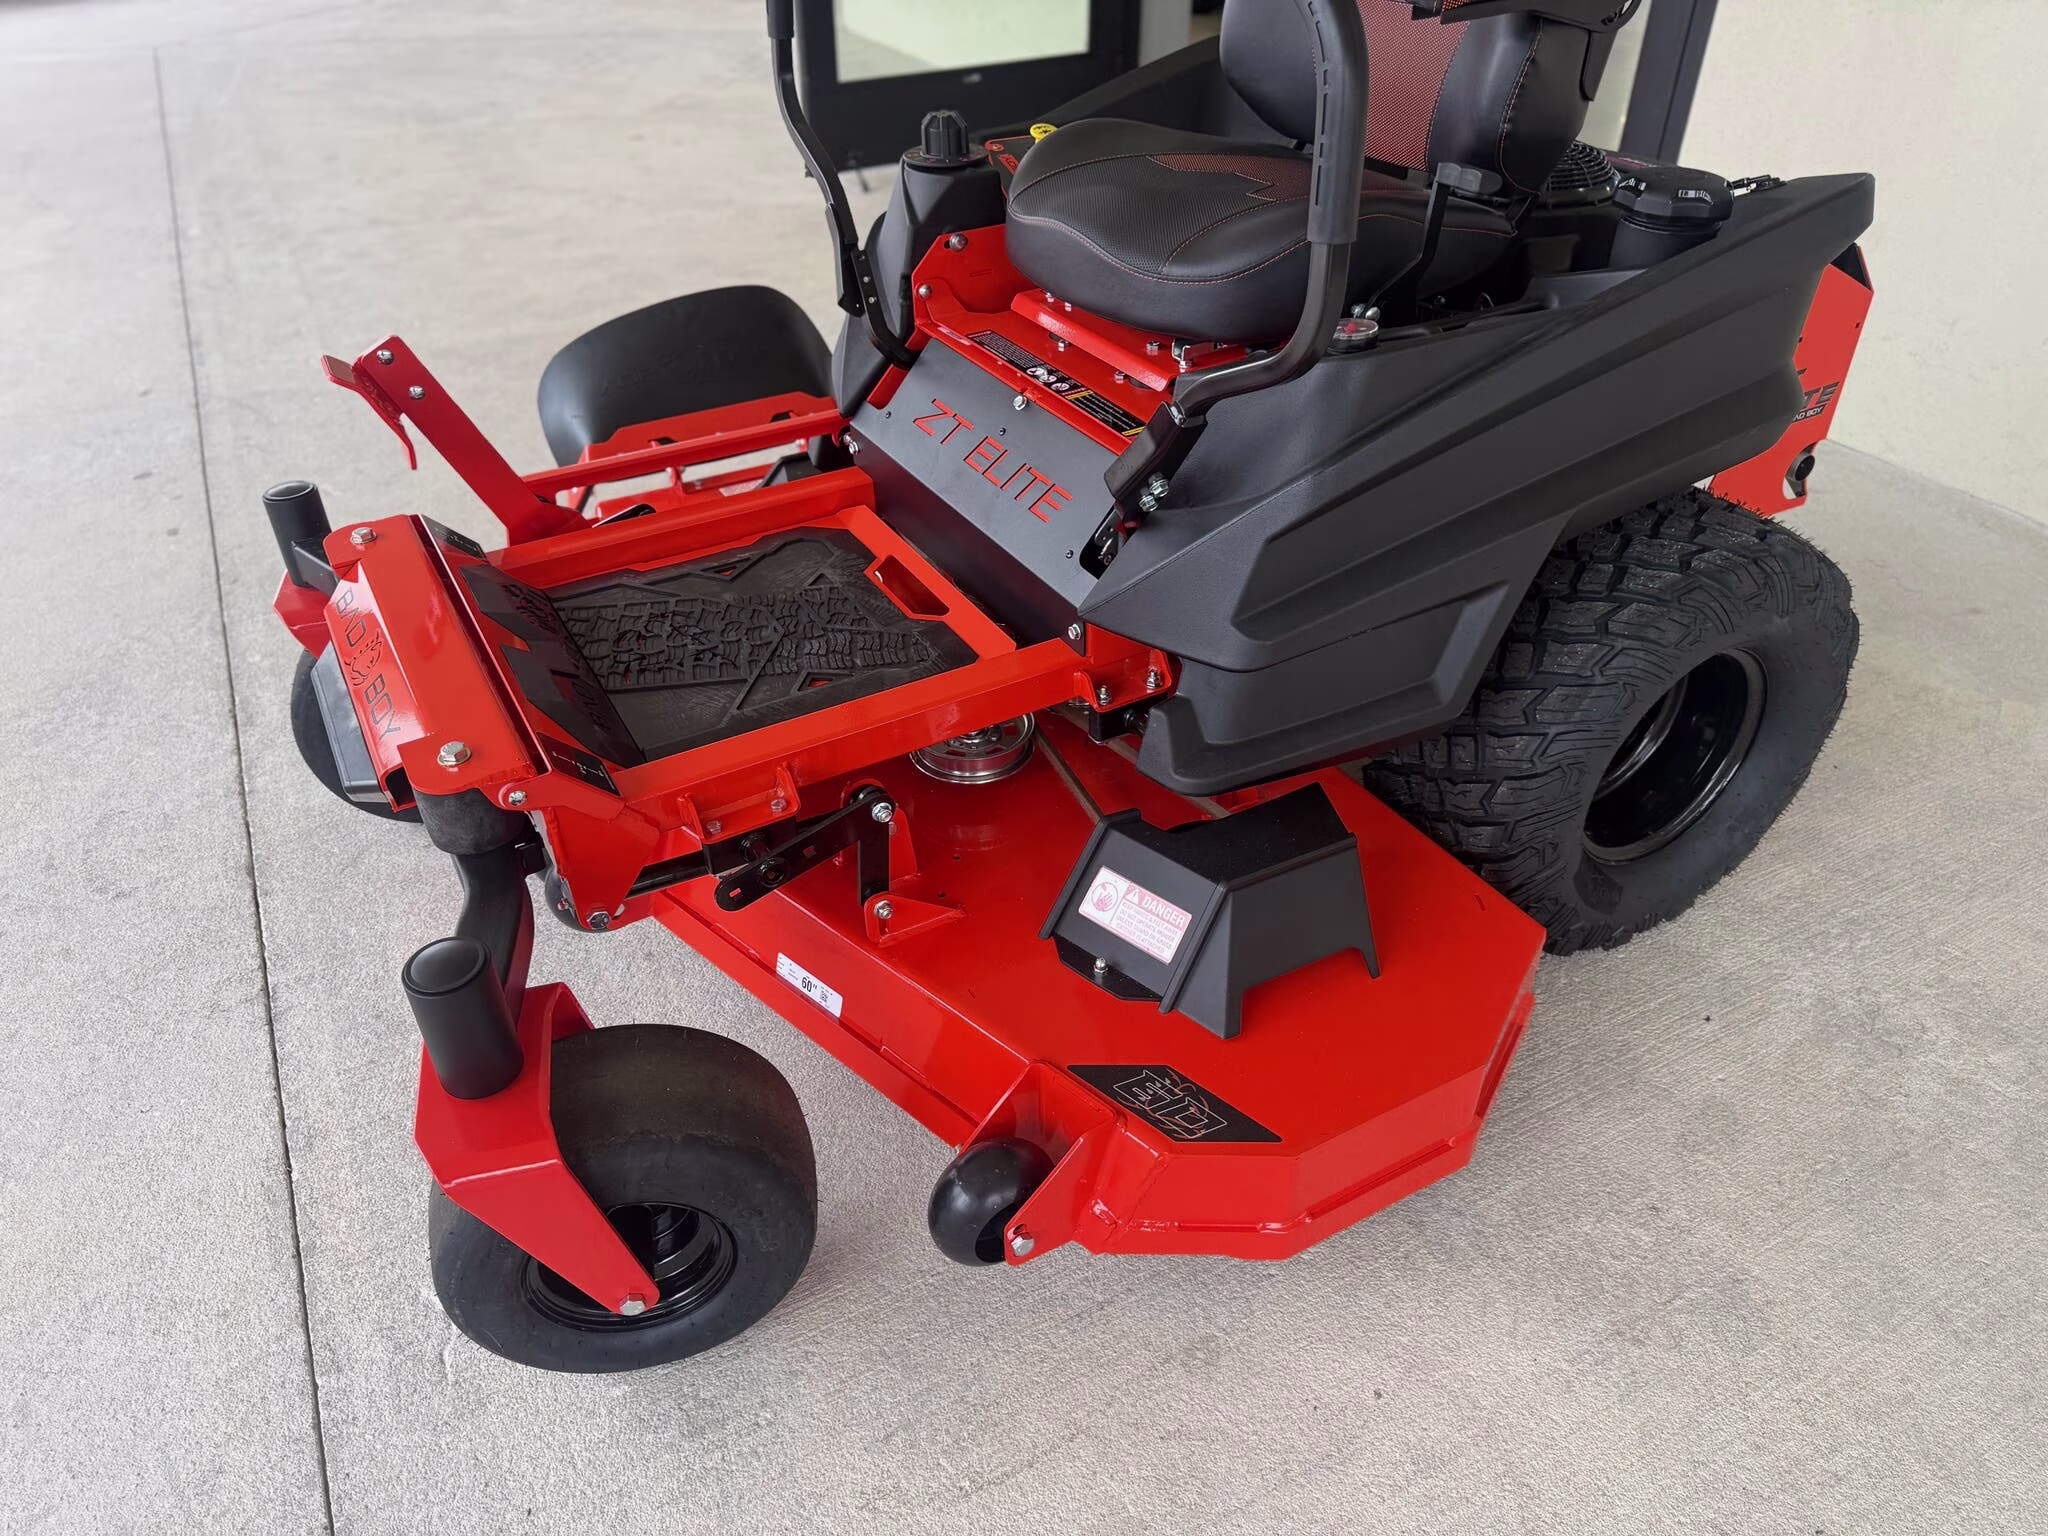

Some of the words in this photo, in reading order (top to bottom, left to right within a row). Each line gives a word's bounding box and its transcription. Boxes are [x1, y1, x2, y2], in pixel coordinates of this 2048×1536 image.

[913, 398, 975, 445] ZT
[963, 436, 1073, 523] ELITE
[336, 588, 366, 648] BAD
[364, 673, 401, 740] BOY
[1141, 895, 1186, 926] DANGER
[801, 976, 818, 993] 60"
